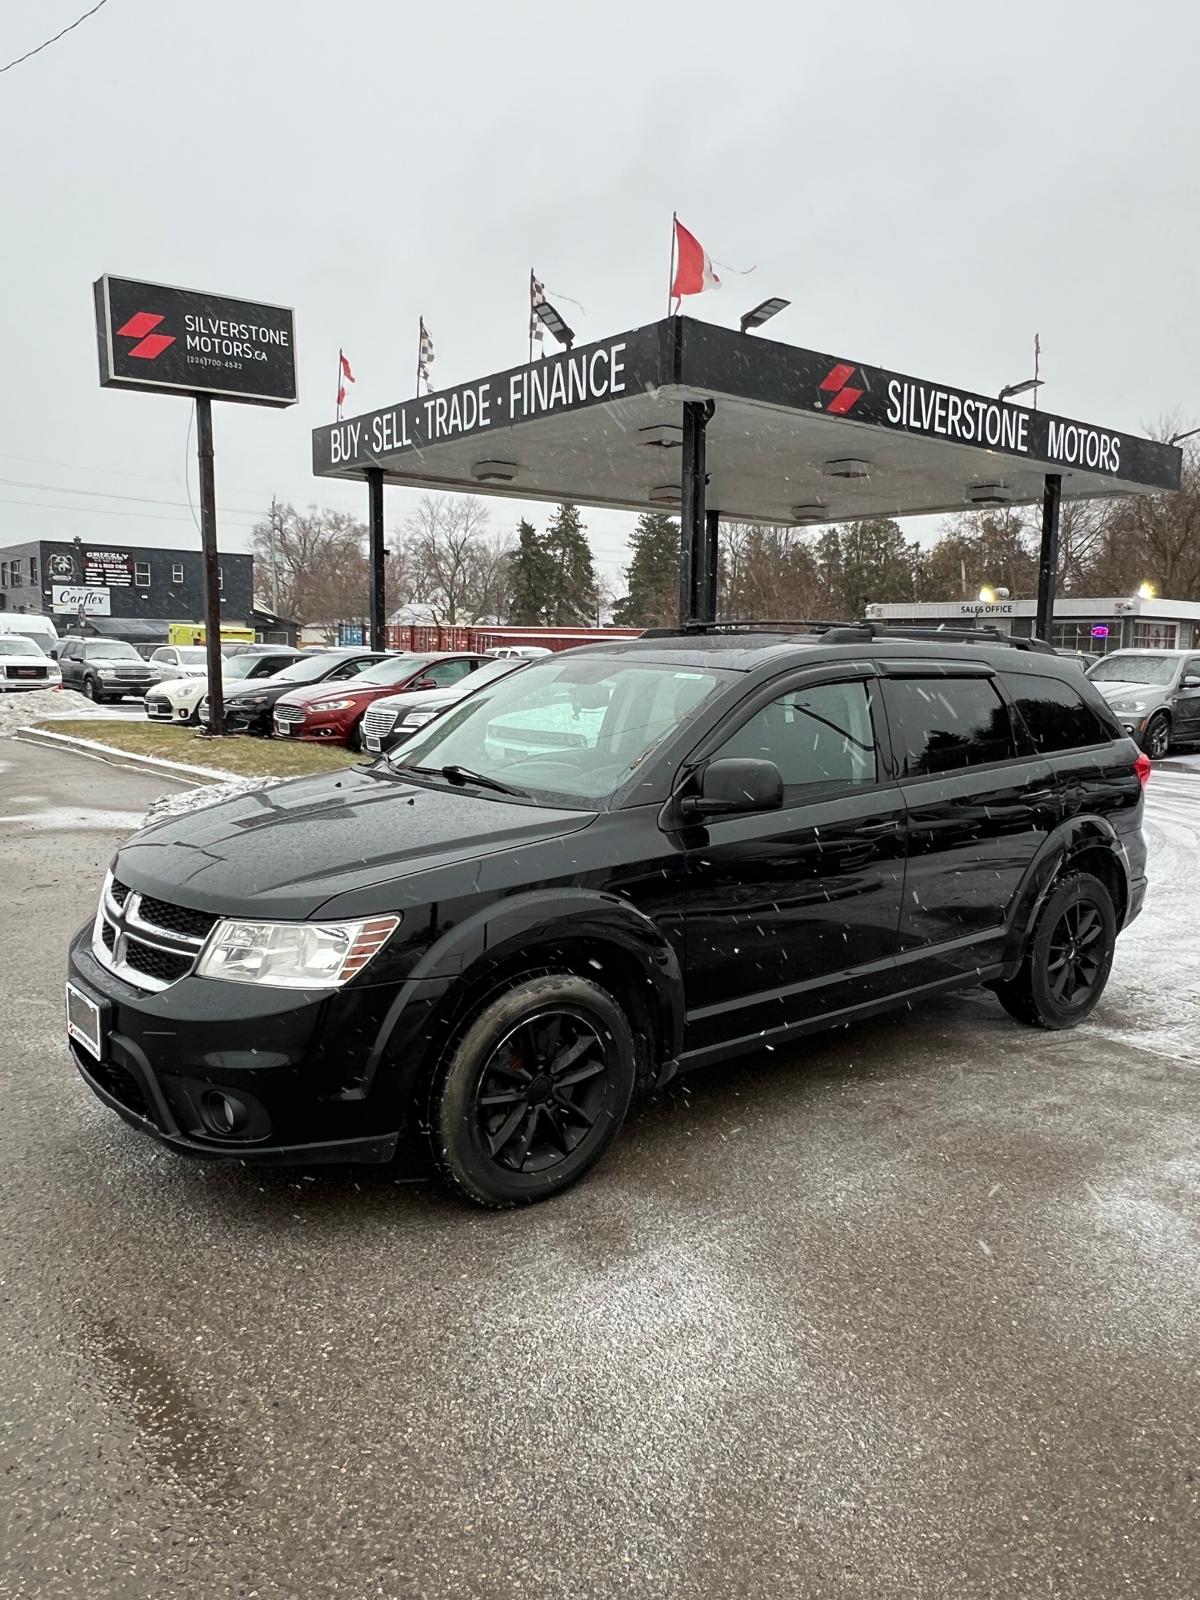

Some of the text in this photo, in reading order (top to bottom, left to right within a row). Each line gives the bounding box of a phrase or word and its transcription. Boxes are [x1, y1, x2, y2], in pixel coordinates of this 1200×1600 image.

[184, 314, 289, 347] SILVERSTONE
[330, 343, 626, 463] BUY SELL TRADE FINANCE
[886, 379, 1121, 472] SILVERSTONE MOTORS
[960, 605, 1013, 614] SALES OFFICE
